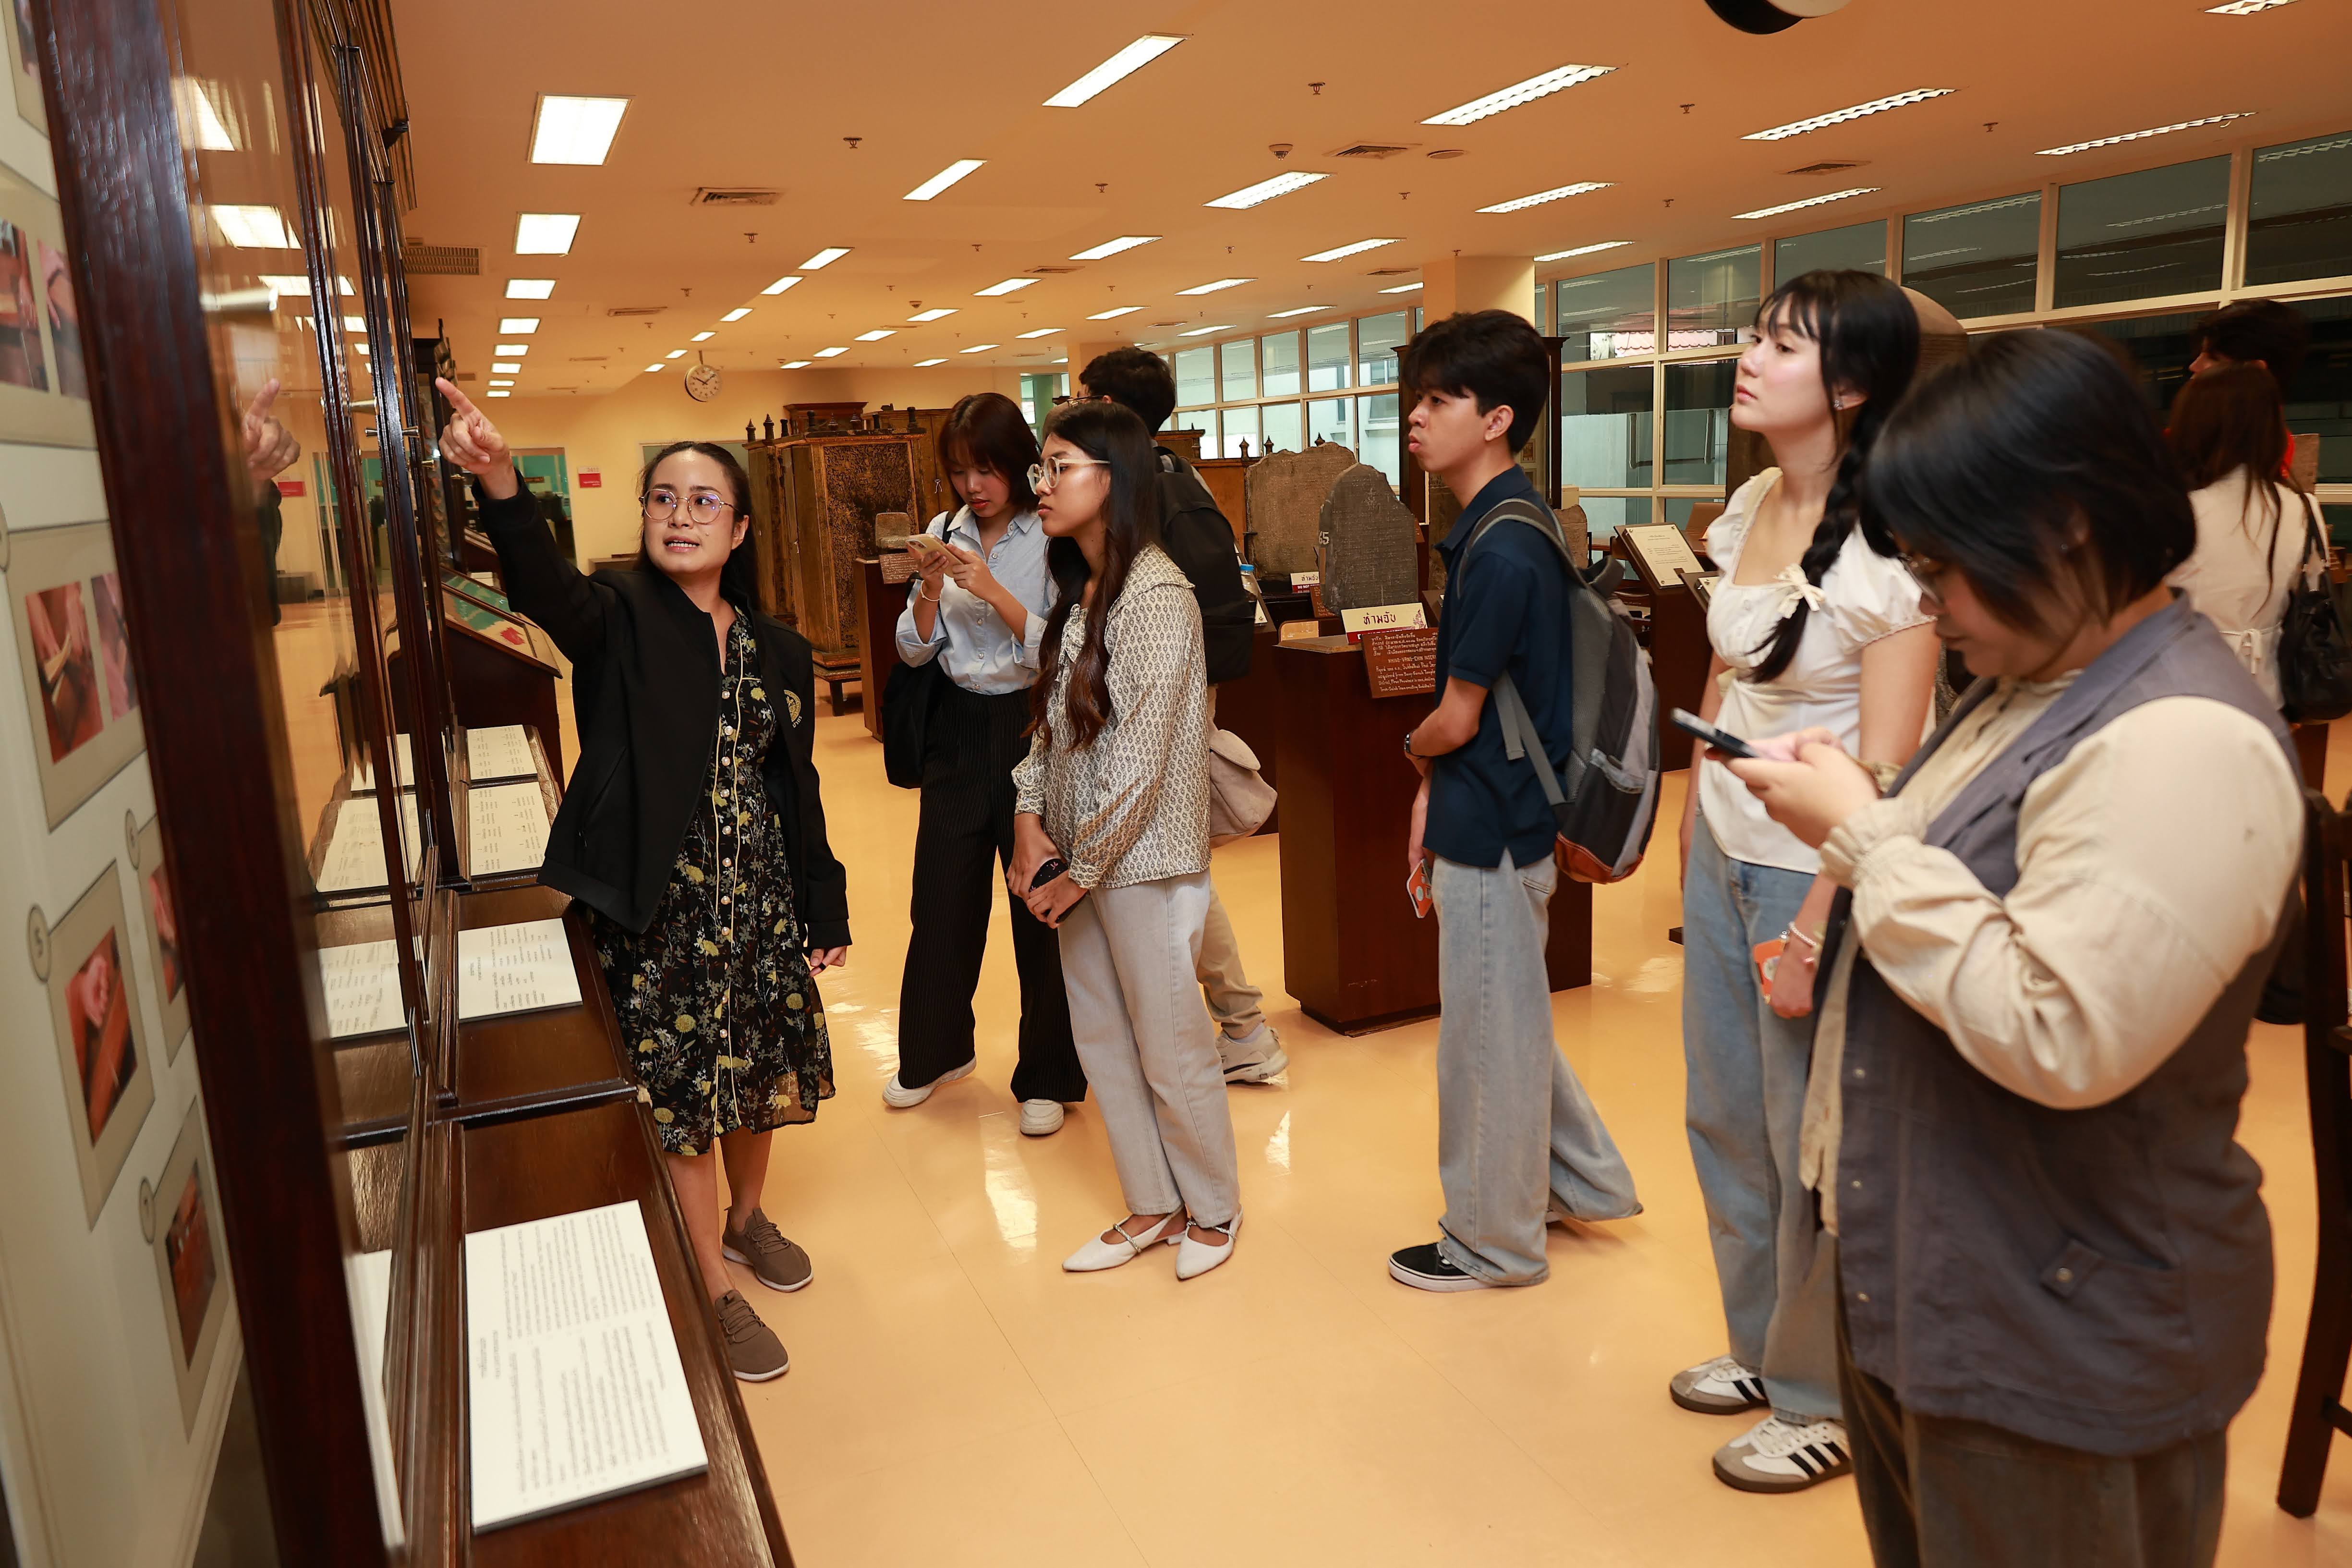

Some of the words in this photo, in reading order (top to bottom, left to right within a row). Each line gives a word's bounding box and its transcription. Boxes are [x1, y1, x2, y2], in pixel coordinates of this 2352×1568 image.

[1319, 530, 1330, 545] 65
[1363, 611, 1396, 625] ห้ามจับ
